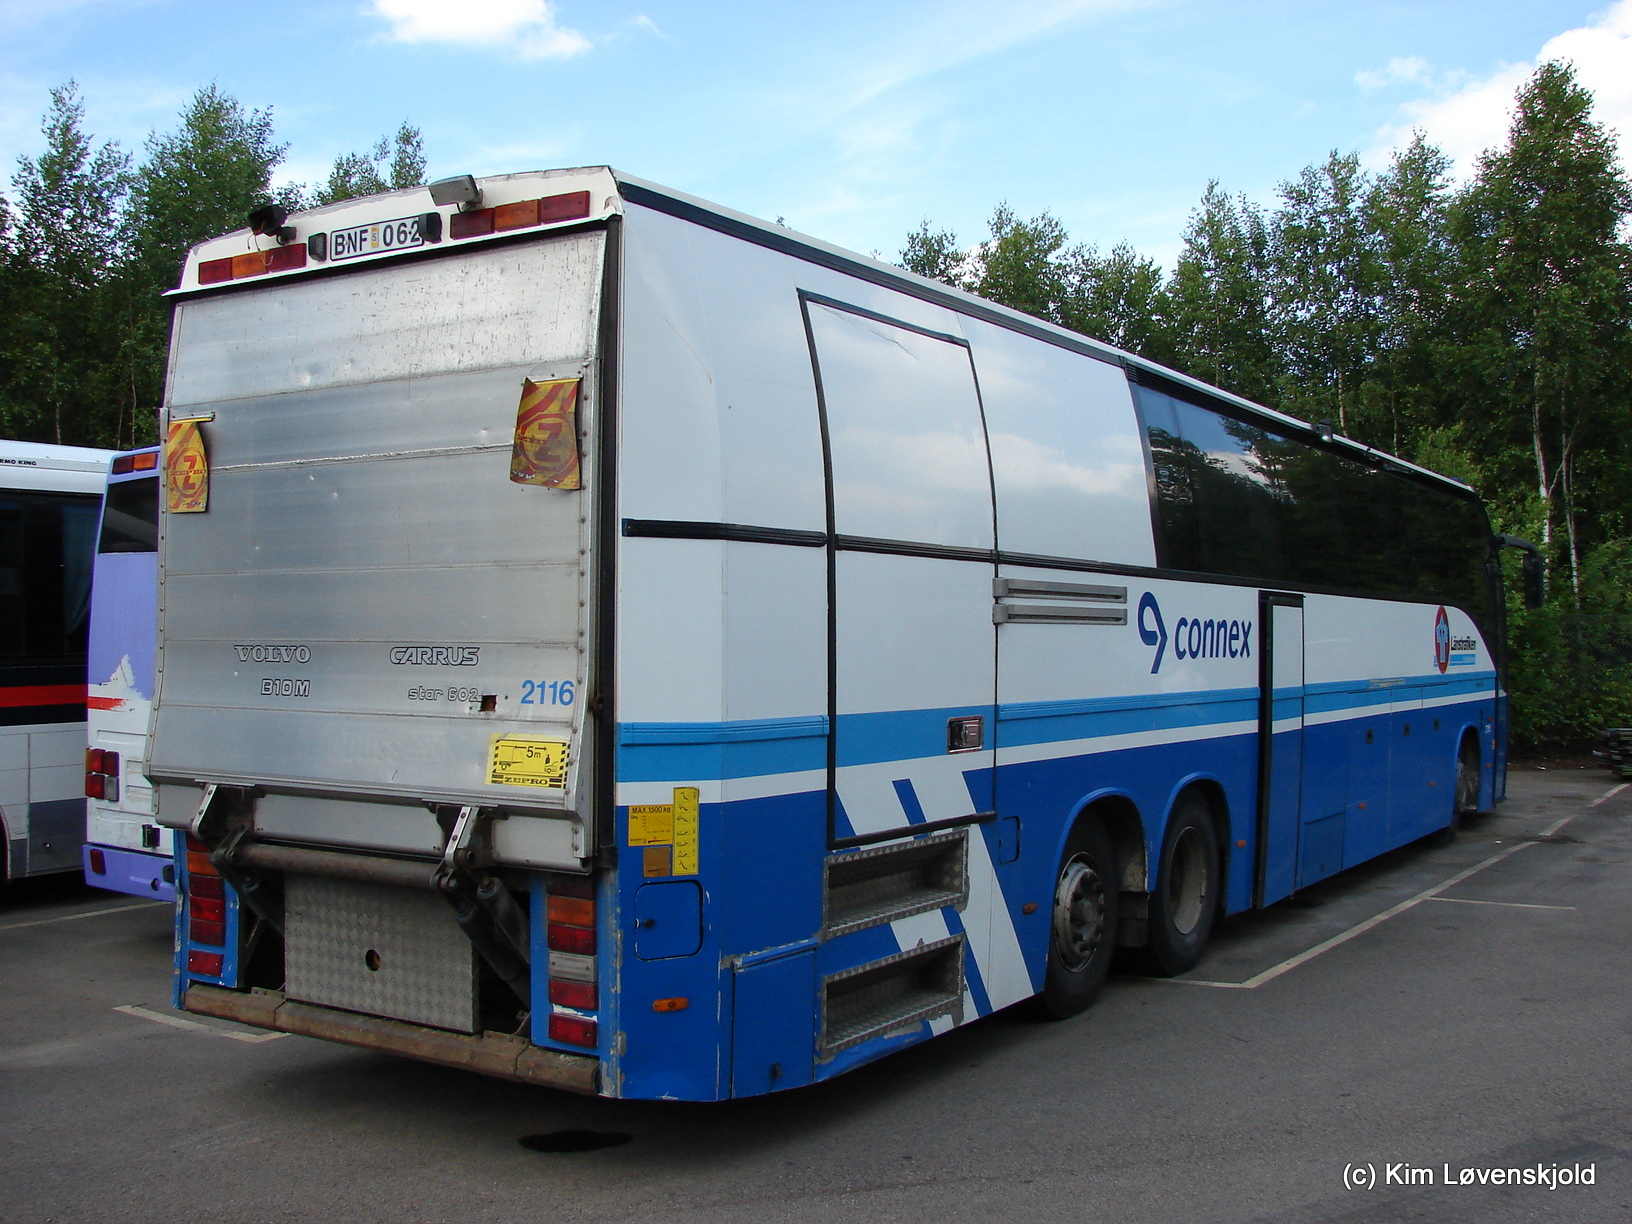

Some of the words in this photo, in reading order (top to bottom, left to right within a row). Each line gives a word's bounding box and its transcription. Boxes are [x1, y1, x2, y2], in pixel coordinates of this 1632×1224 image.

[335, 229, 368, 255] BNF
[383, 220, 420, 246] 062
[1174, 617, 1252, 660] connex
[234, 645, 312, 663] VOLVO
[390, 646, 480, 666] CARRUS
[261, 678, 311, 697] B10M
[408, 686, 444, 700] star
[447, 687, 480, 702] 602
[520, 680, 575, 706] 2116
[504, 776, 548, 785] ZEPRO
